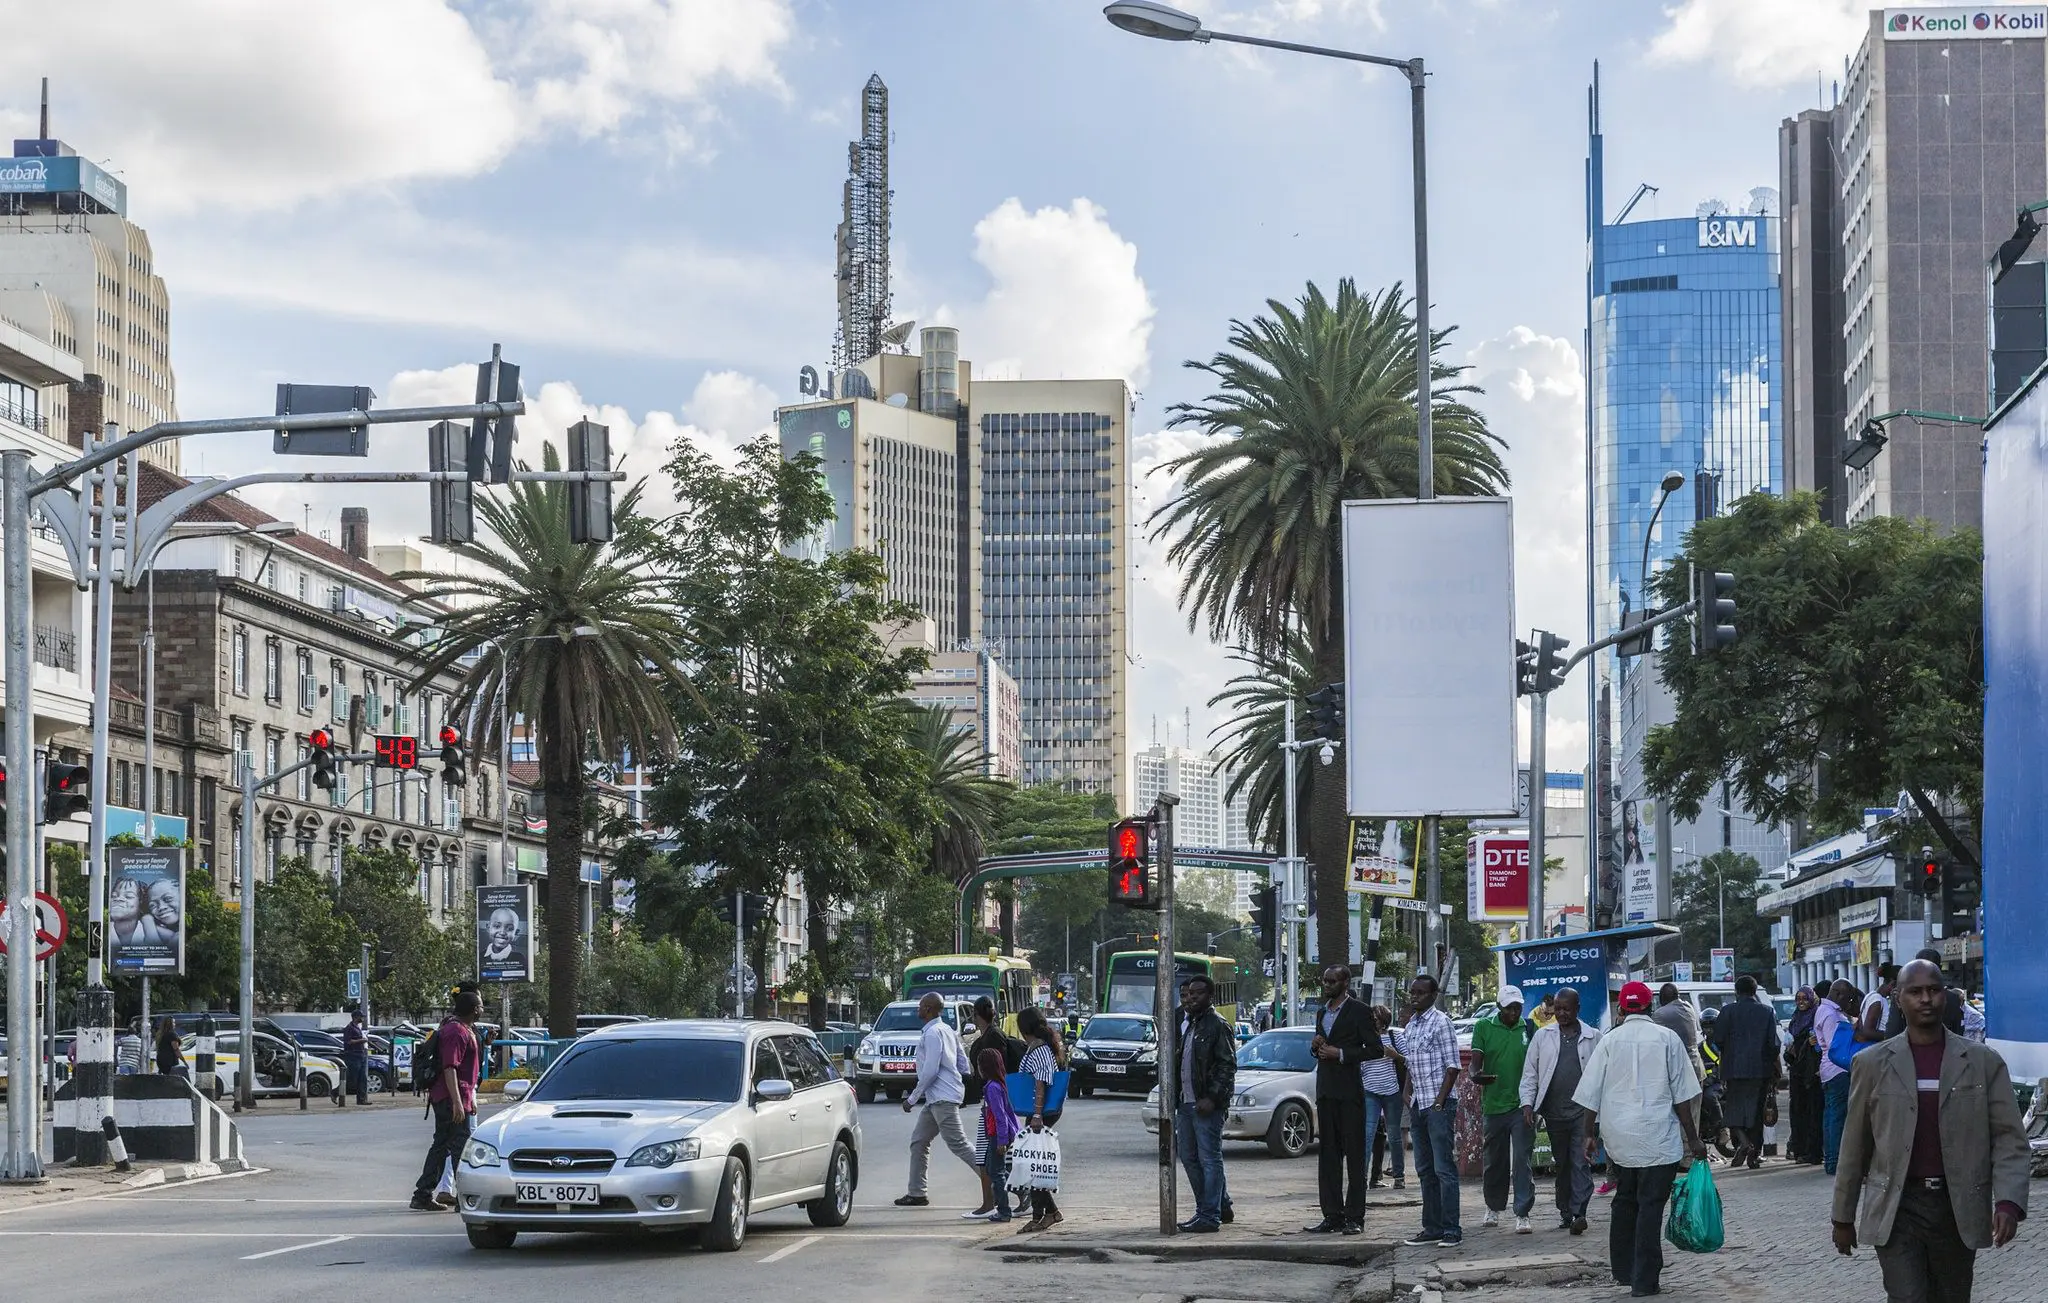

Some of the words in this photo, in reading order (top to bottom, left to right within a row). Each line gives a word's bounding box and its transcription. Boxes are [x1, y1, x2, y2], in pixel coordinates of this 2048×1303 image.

[1912, 14, 1967, 31] Kenol
[1994, 13, 2044, 30] Kobil
[1699, 220, 1756, 246] I&M
[376, 736, 415, 769] 48
[150, 857, 170, 865] family
[1397, 899, 1419, 910] KIMATHI
[1512, 947, 1600, 966] SportPesa
[1136, 960, 1155, 968] Citi
[926, 973, 945, 981] Citi
[1522, 978, 1548, 986] SMS
[1550, 975, 1589, 985] 79079
[1013, 1149, 1056, 1161] BACKYARD
[517, 1186, 547, 1201] KBL
[556, 1186, 597, 1201] 807J
